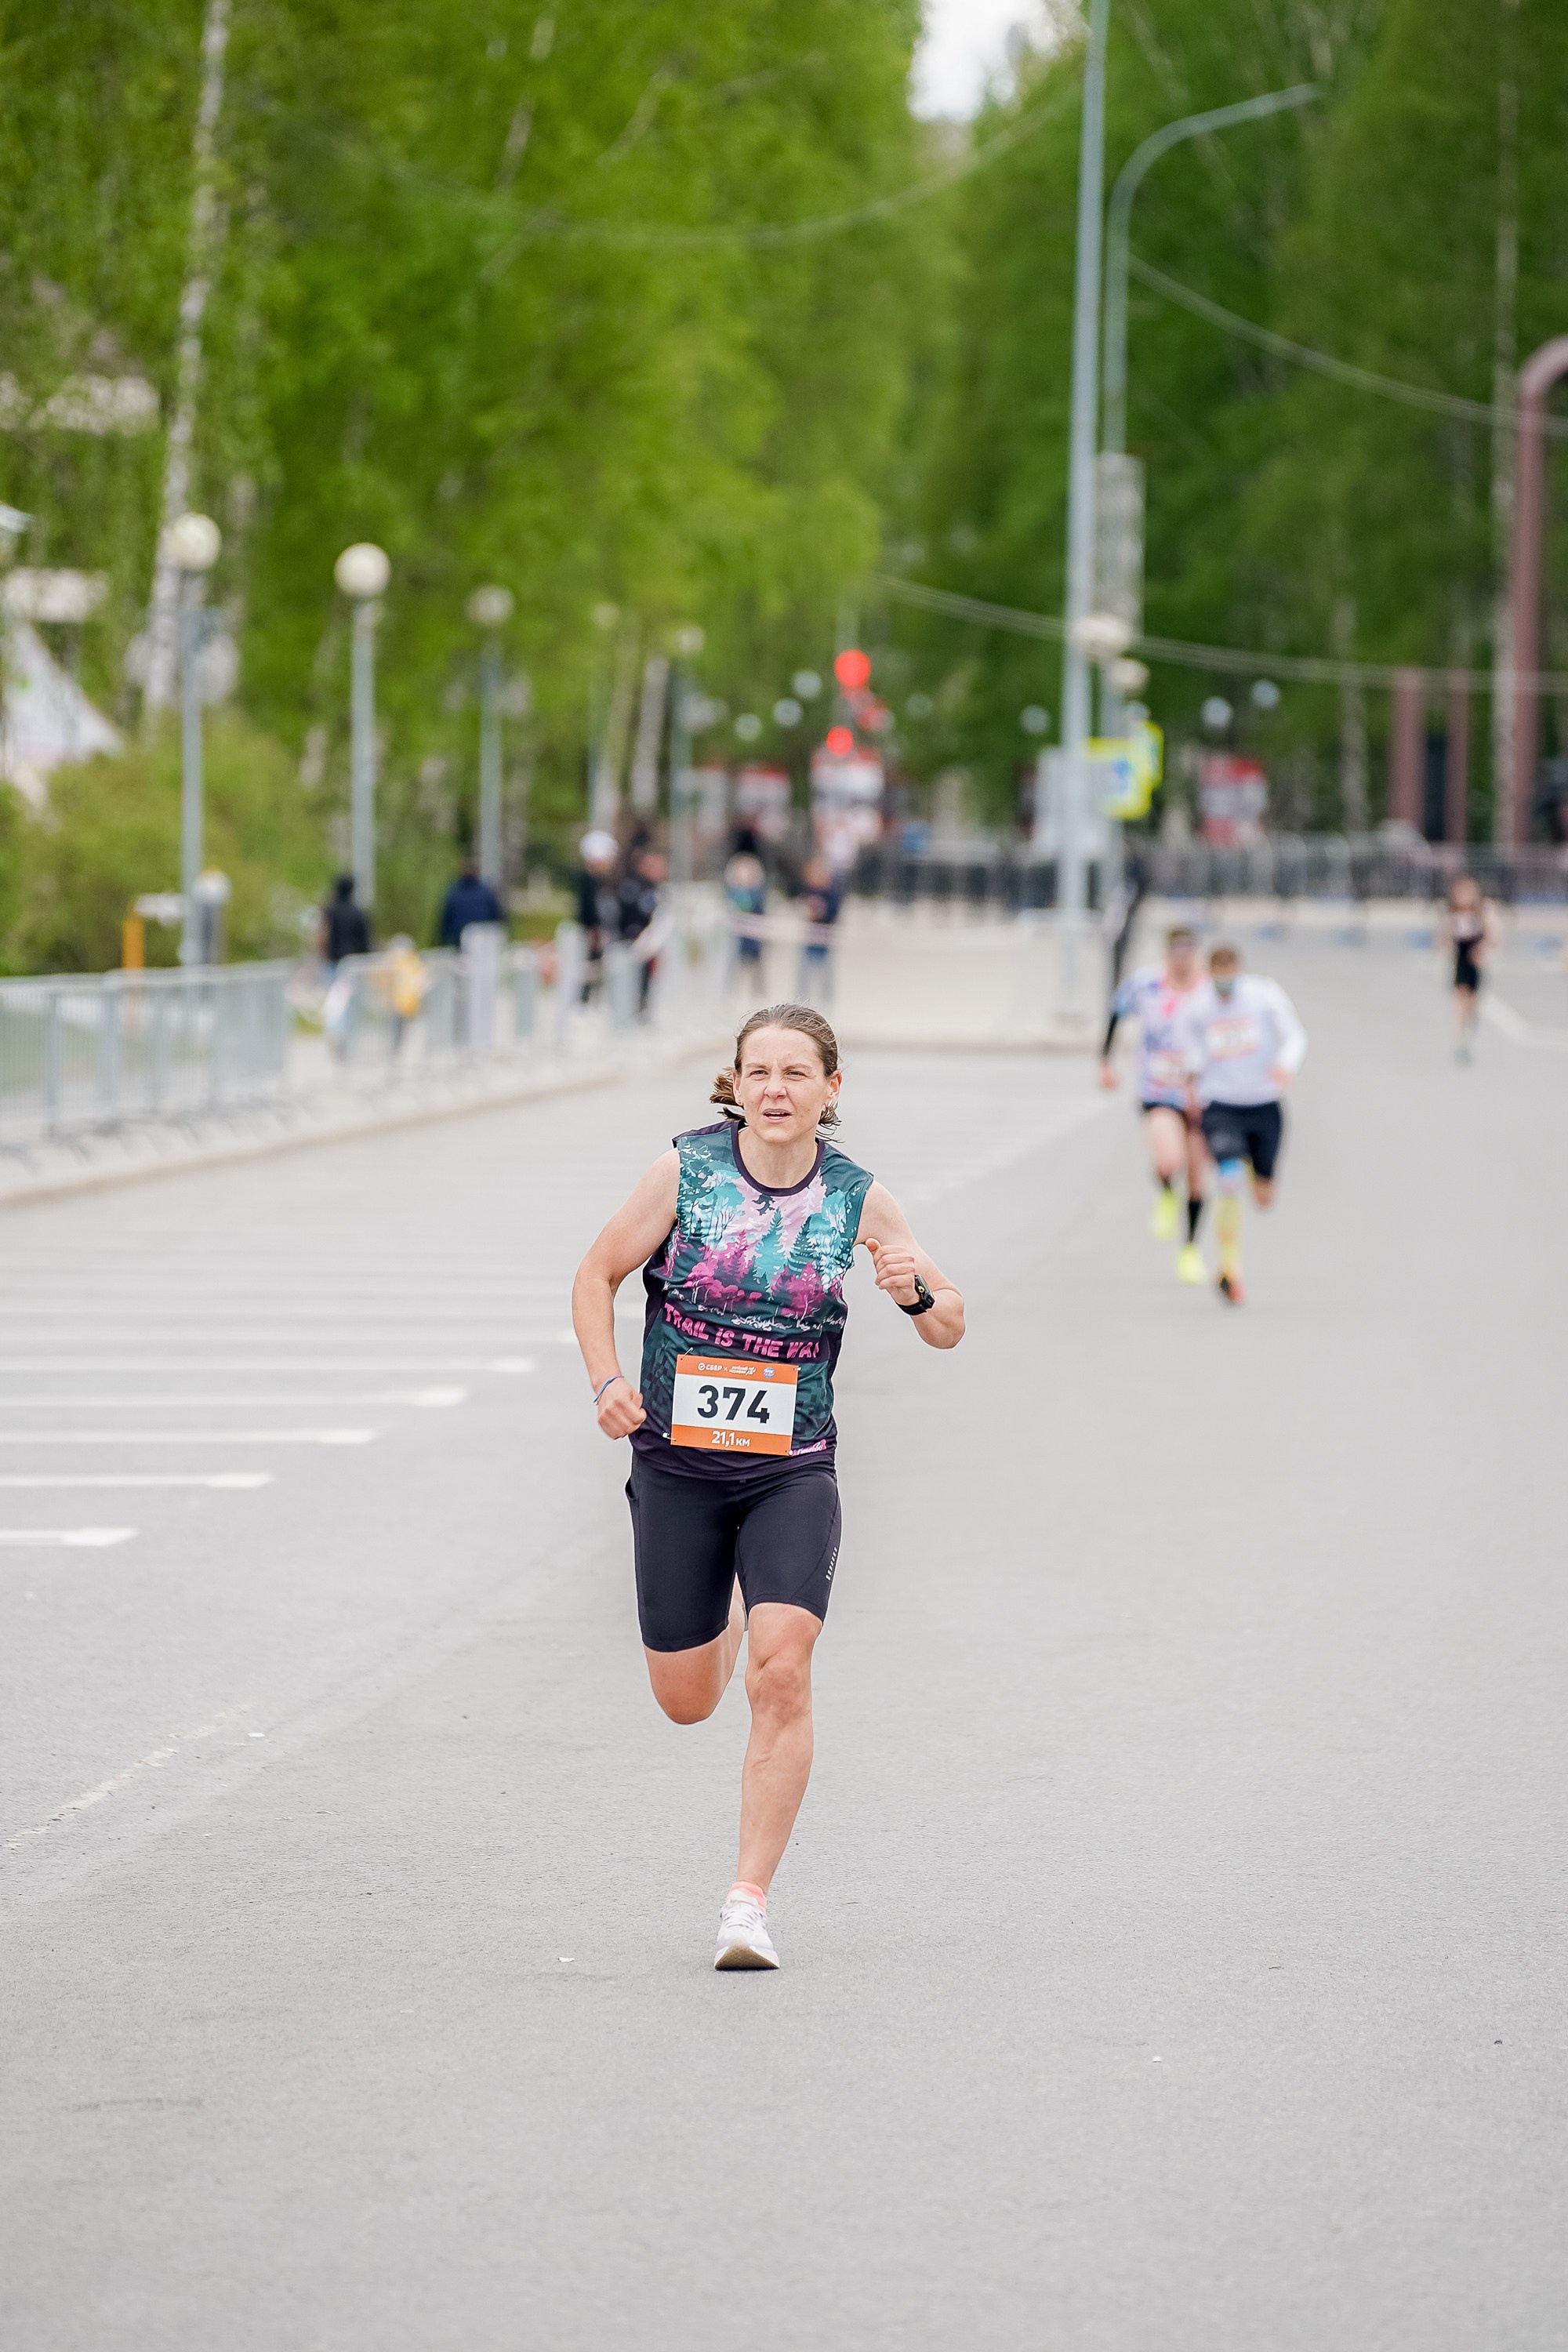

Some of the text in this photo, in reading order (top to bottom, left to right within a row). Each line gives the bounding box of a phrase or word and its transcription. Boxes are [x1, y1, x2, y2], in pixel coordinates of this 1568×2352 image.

[664, 1302, 709, 1340] TRAIL
[714, 1327, 735, 1347] IS
[742, 1334, 783, 1357] THE
[697, 1385, 770, 1424] 374
